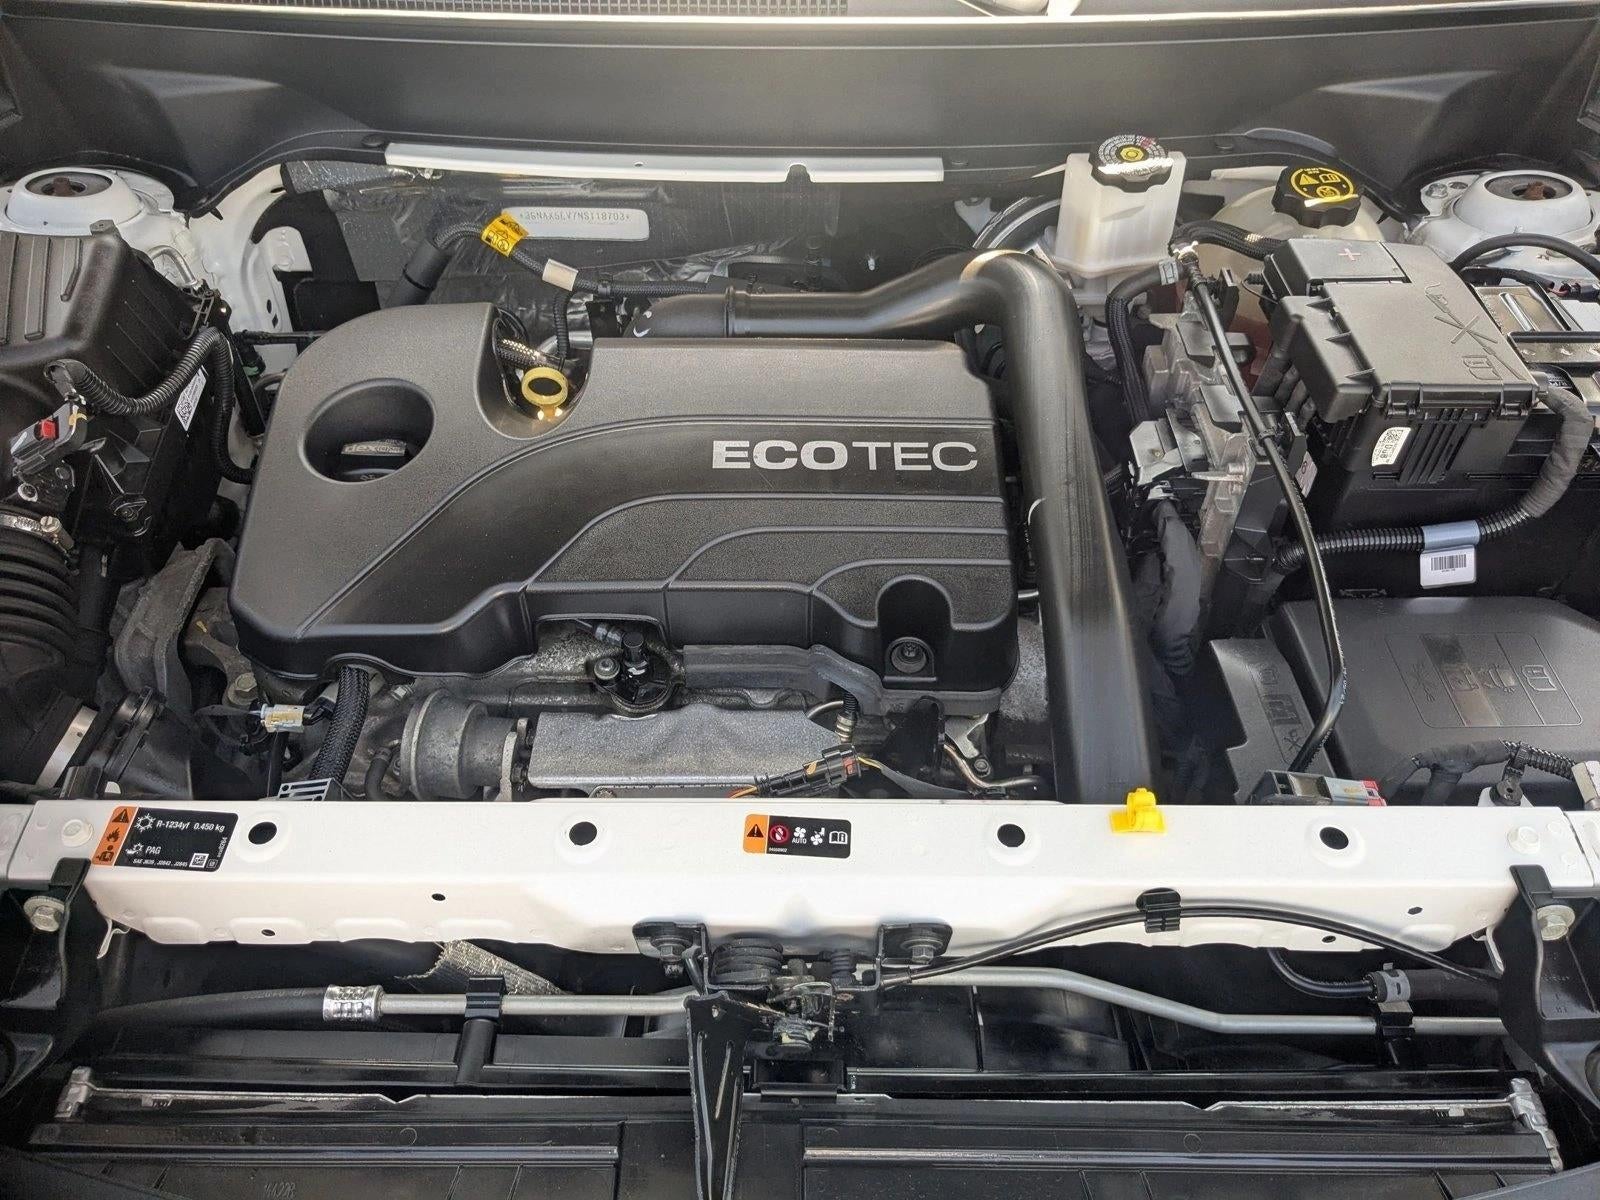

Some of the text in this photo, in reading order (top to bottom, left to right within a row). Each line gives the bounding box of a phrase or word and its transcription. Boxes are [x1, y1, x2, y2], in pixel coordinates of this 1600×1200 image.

[712, 439, 979, 472] ECOTEC
[156, 820, 225, 833] R-1234yf 0.450 kg
[791, 837, 807, 845] AUTO
[145, 845, 162, 855] PAG
